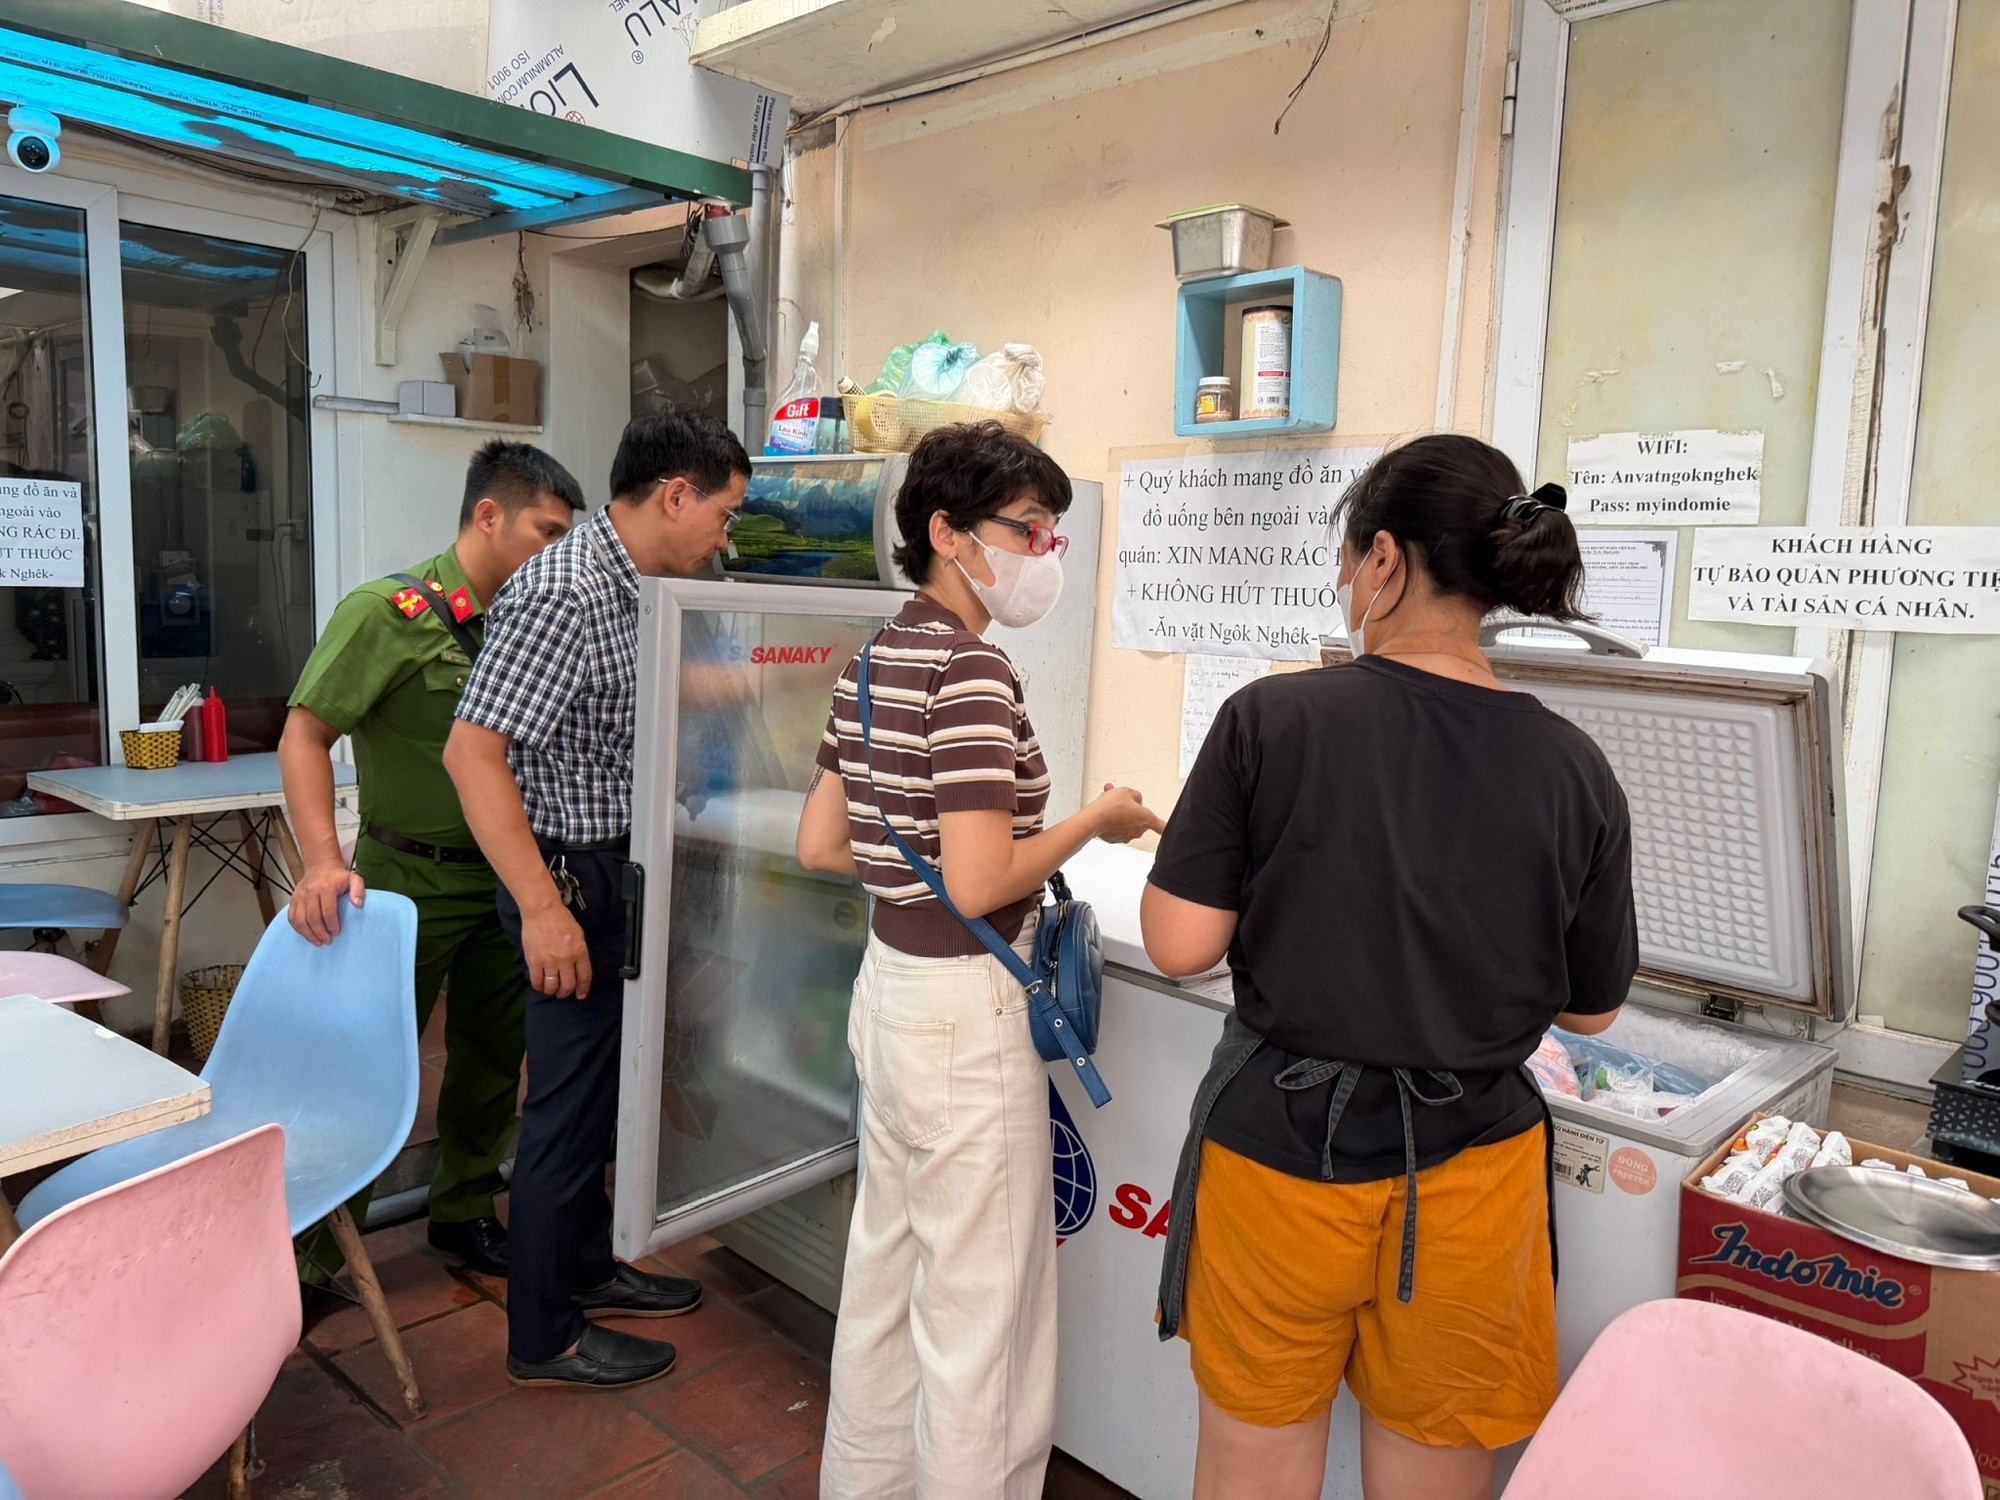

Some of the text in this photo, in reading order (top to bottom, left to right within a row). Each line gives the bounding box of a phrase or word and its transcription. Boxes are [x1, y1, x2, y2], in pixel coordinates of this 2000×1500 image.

[624, 0, 698, 46] ALU
[487, 50, 531, 90] ISO 9001
[516, 44, 564, 90] ALUMINIUM
[520, 62, 599, 116] LIO
[786, 402, 810, 418] Gift
[1637, 439, 1688, 455] WIFI:
[1139, 470, 1173, 494] Quý
[1179, 467, 1227, 488] khách
[1233, 469, 1283, 491] mang
[1289, 458, 1313, 485] đồ
[1320, 464, 1342, 484] ăn
[1572, 466, 1759, 487] Tên: Anvatngoknghek
[23, 481, 40, 496] đồ
[43, 486, 59, 498] ăn
[62, 487, 78, 499] và
[39, 507, 62, 519] vào
[1142, 502, 1162, 527] đồ
[1168, 502, 1208, 531] uống
[1214, 507, 1244, 527] bên
[1250, 505, 1299, 531] ngoài
[1589, 497, 1731, 515] Pass: myindomie
[23, 524, 55, 539] RÁC
[1772, 533, 1932, 555] KHÁCH HÀNG
[1119, 546, 1161, 568] quán:
[1167, 546, 1201, 564] XIN
[1208, 546, 1274, 566] MANG
[1280, 540, 1328, 567] RÁC
[1694, 565, 1725, 586] TỰ
[1728, 563, 1770, 583] BẢO
[1776, 563, 1840, 587] QUẢN
[1848, 566, 1955, 588] PHƯƠNG
[1141, 578, 1215, 604] KHÔNG
[1221, 579, 1265, 605] HÚT
[1271, 581, 1341, 608] THUỐ
[1728, 593, 1974, 619] VÀ TÀI SẢN CÁ NHÂN.
[1182, 621, 1204, 641] vặt
[1210, 622, 1251, 644] Ngôk
[1257, 625, 1319, 648] Nghêk-
[750, 646, 832, 665] SANAKY
[1612, 1167, 1650, 1188] FREEZER
